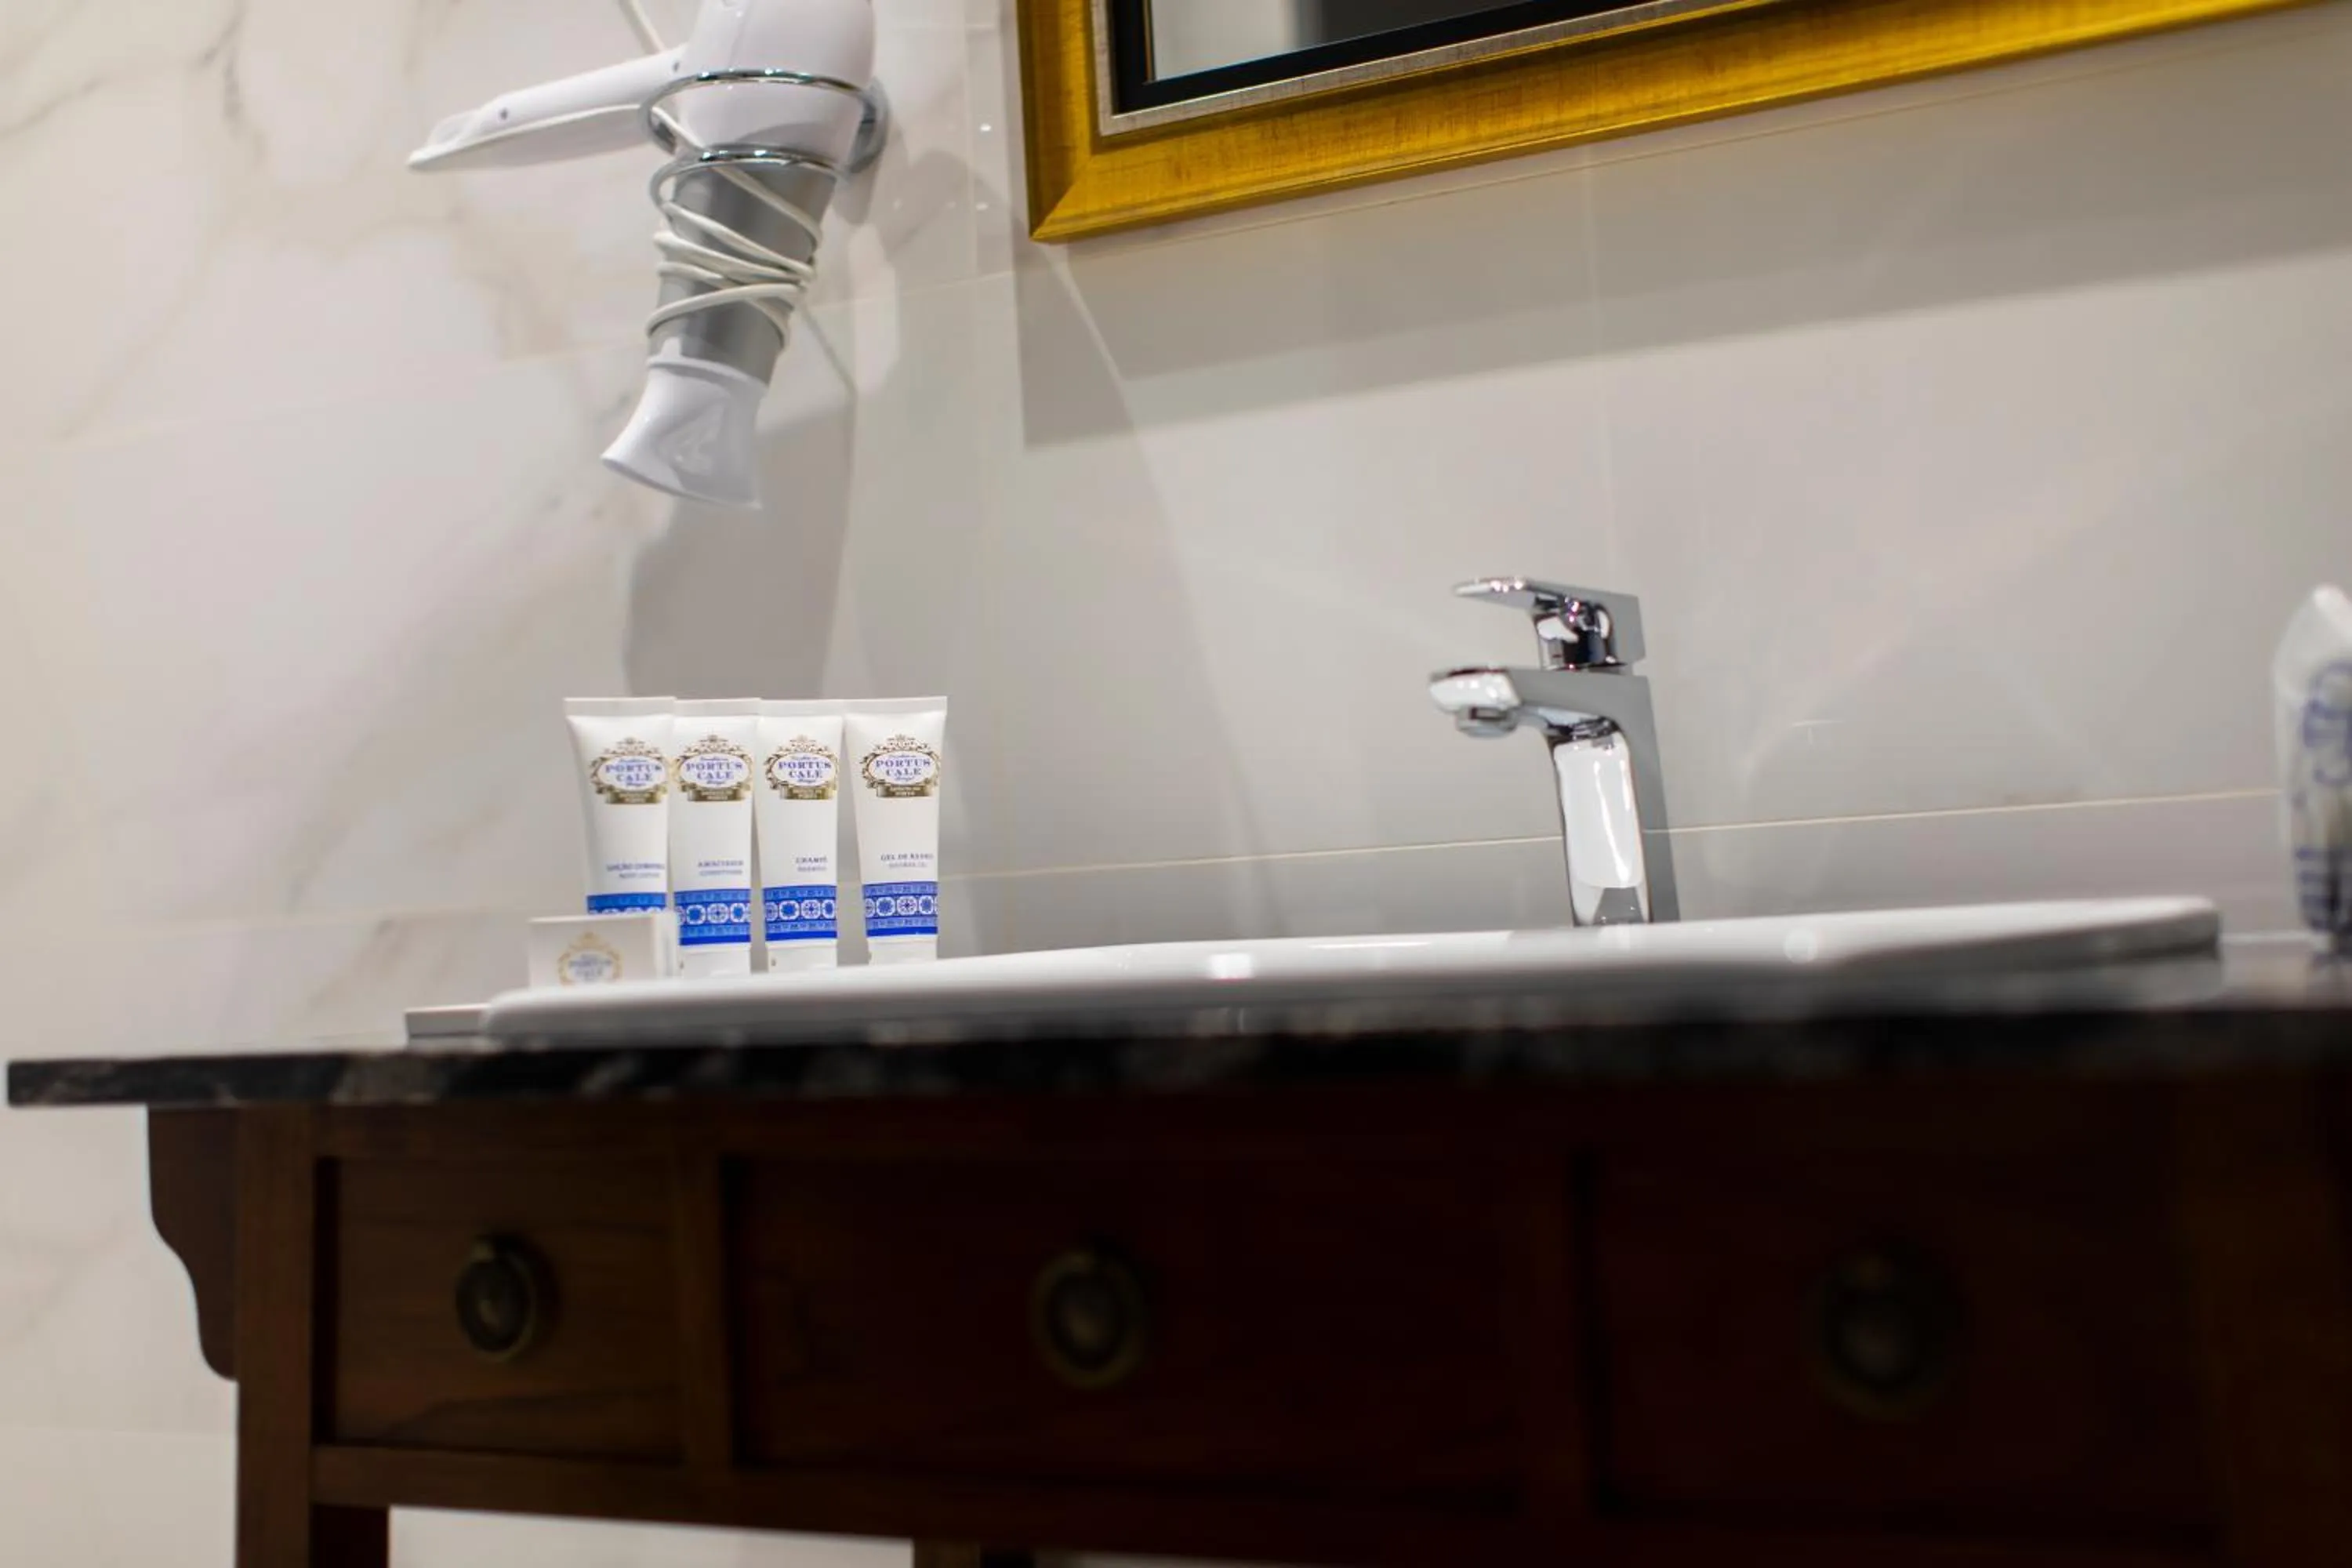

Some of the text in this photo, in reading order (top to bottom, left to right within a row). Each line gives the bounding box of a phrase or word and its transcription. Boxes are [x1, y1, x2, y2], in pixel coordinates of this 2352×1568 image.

[685, 761, 742, 771] PORTUS
[777, 760, 831, 769] PORTUS
[875, 757, 931, 768] PORTUS
[605, 764, 662, 773] PORTUS
[885, 768, 922, 776] CALE
[615, 773, 652, 782] CALE
[696, 771, 734, 779] CALE
[788, 770, 823, 779] CALE
